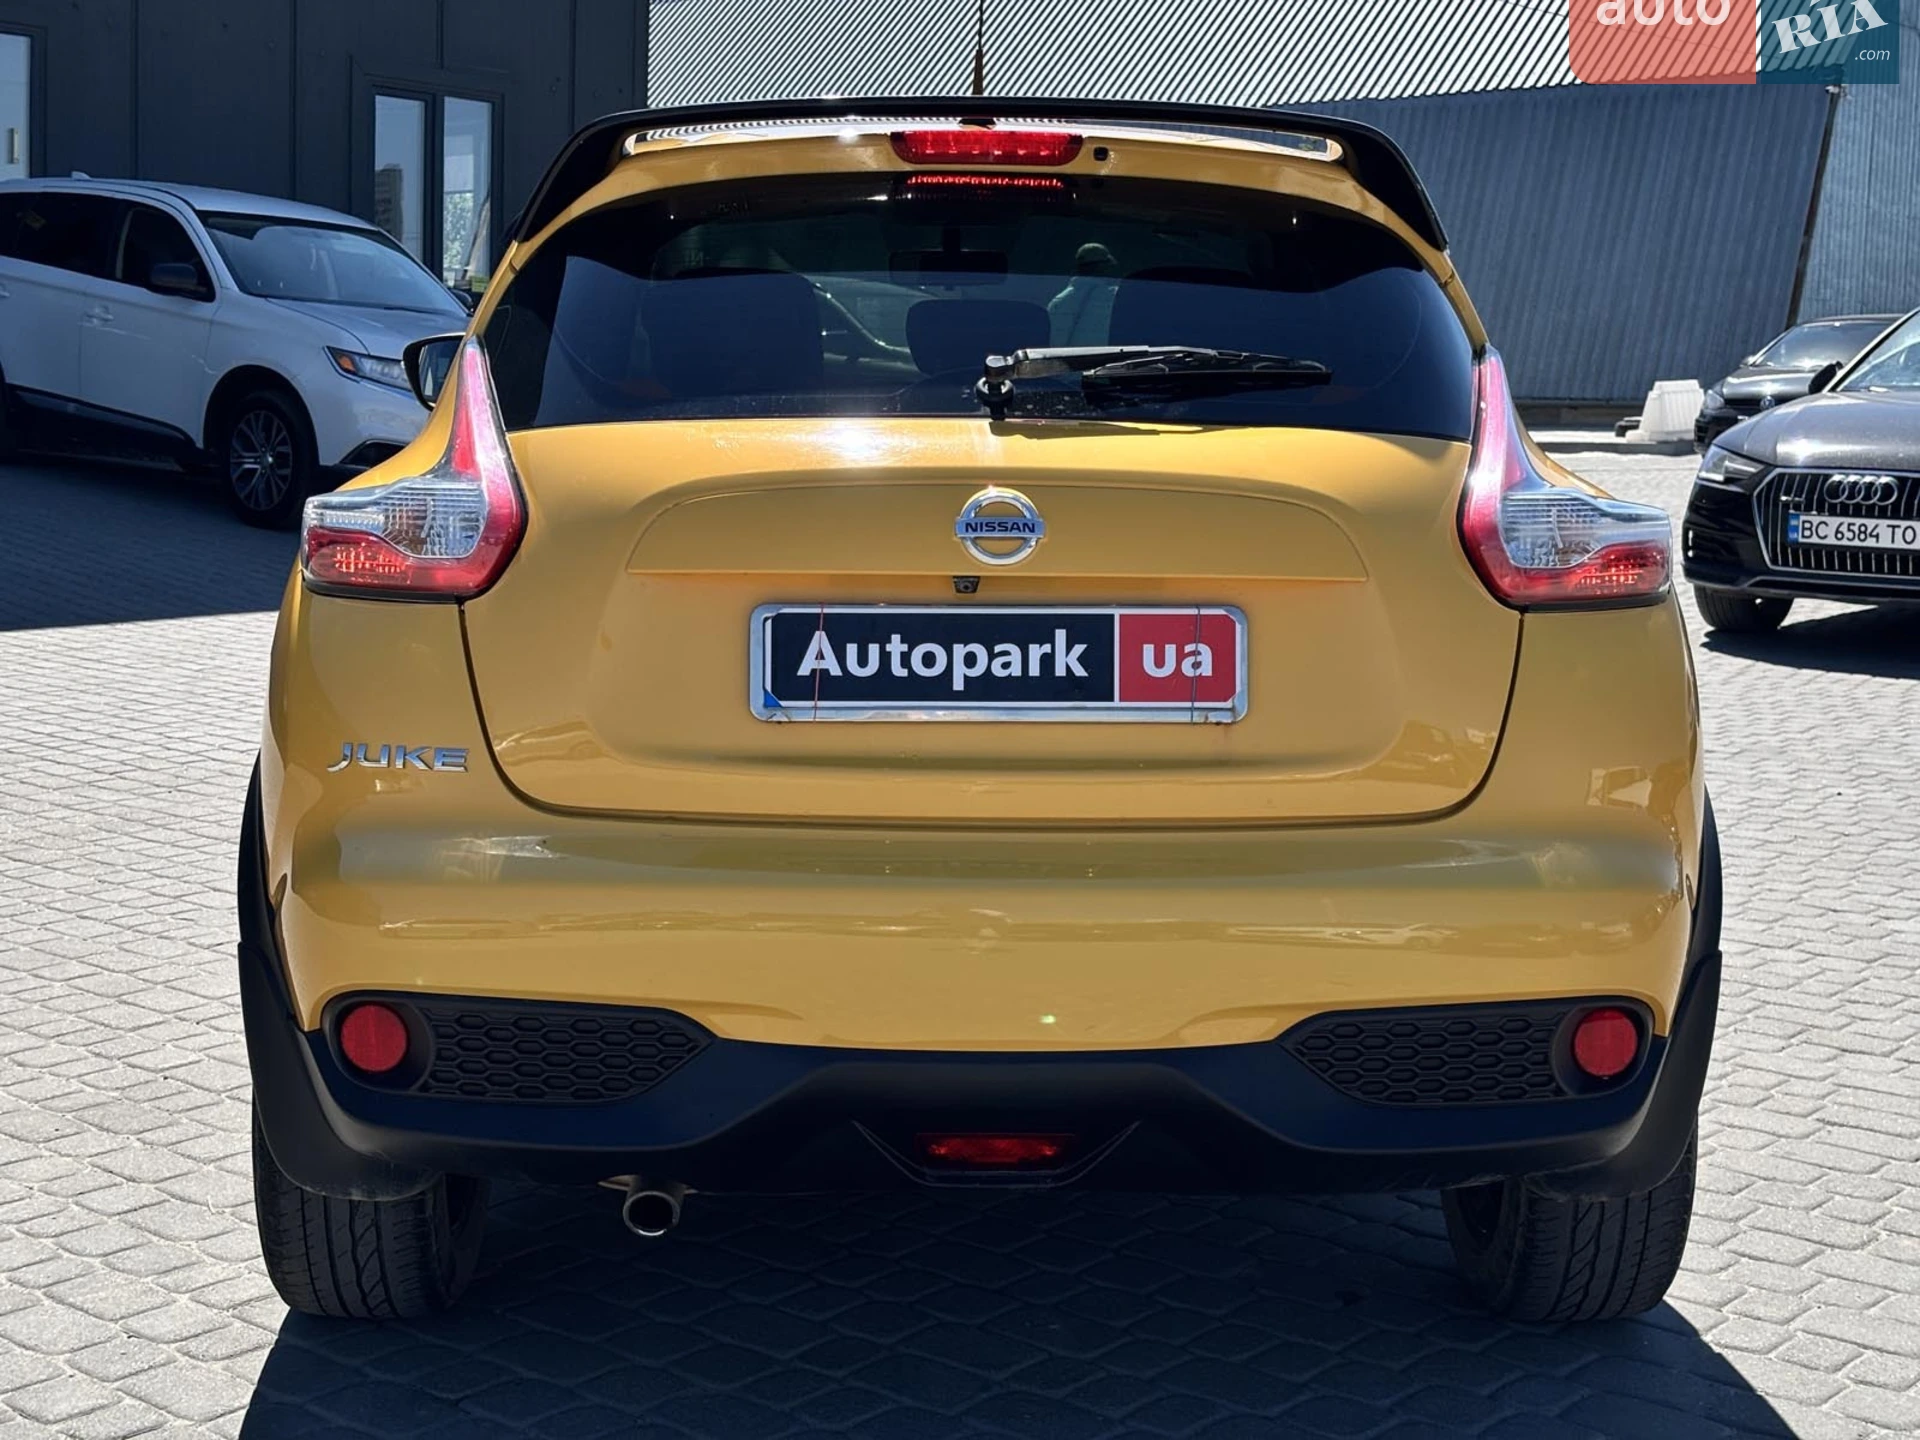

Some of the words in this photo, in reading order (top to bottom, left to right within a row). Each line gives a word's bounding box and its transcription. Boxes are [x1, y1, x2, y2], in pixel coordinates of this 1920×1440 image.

[964, 521, 1036, 533] NISSAN
[1801, 520, 1829, 540] BC
[1835, 521, 1881, 544] 6584
[1886, 524, 1917, 545] TO
[796, 629, 1089, 691] Autopark
[1142, 642, 1213, 677] ua
[326, 742, 469, 773] JUKE
